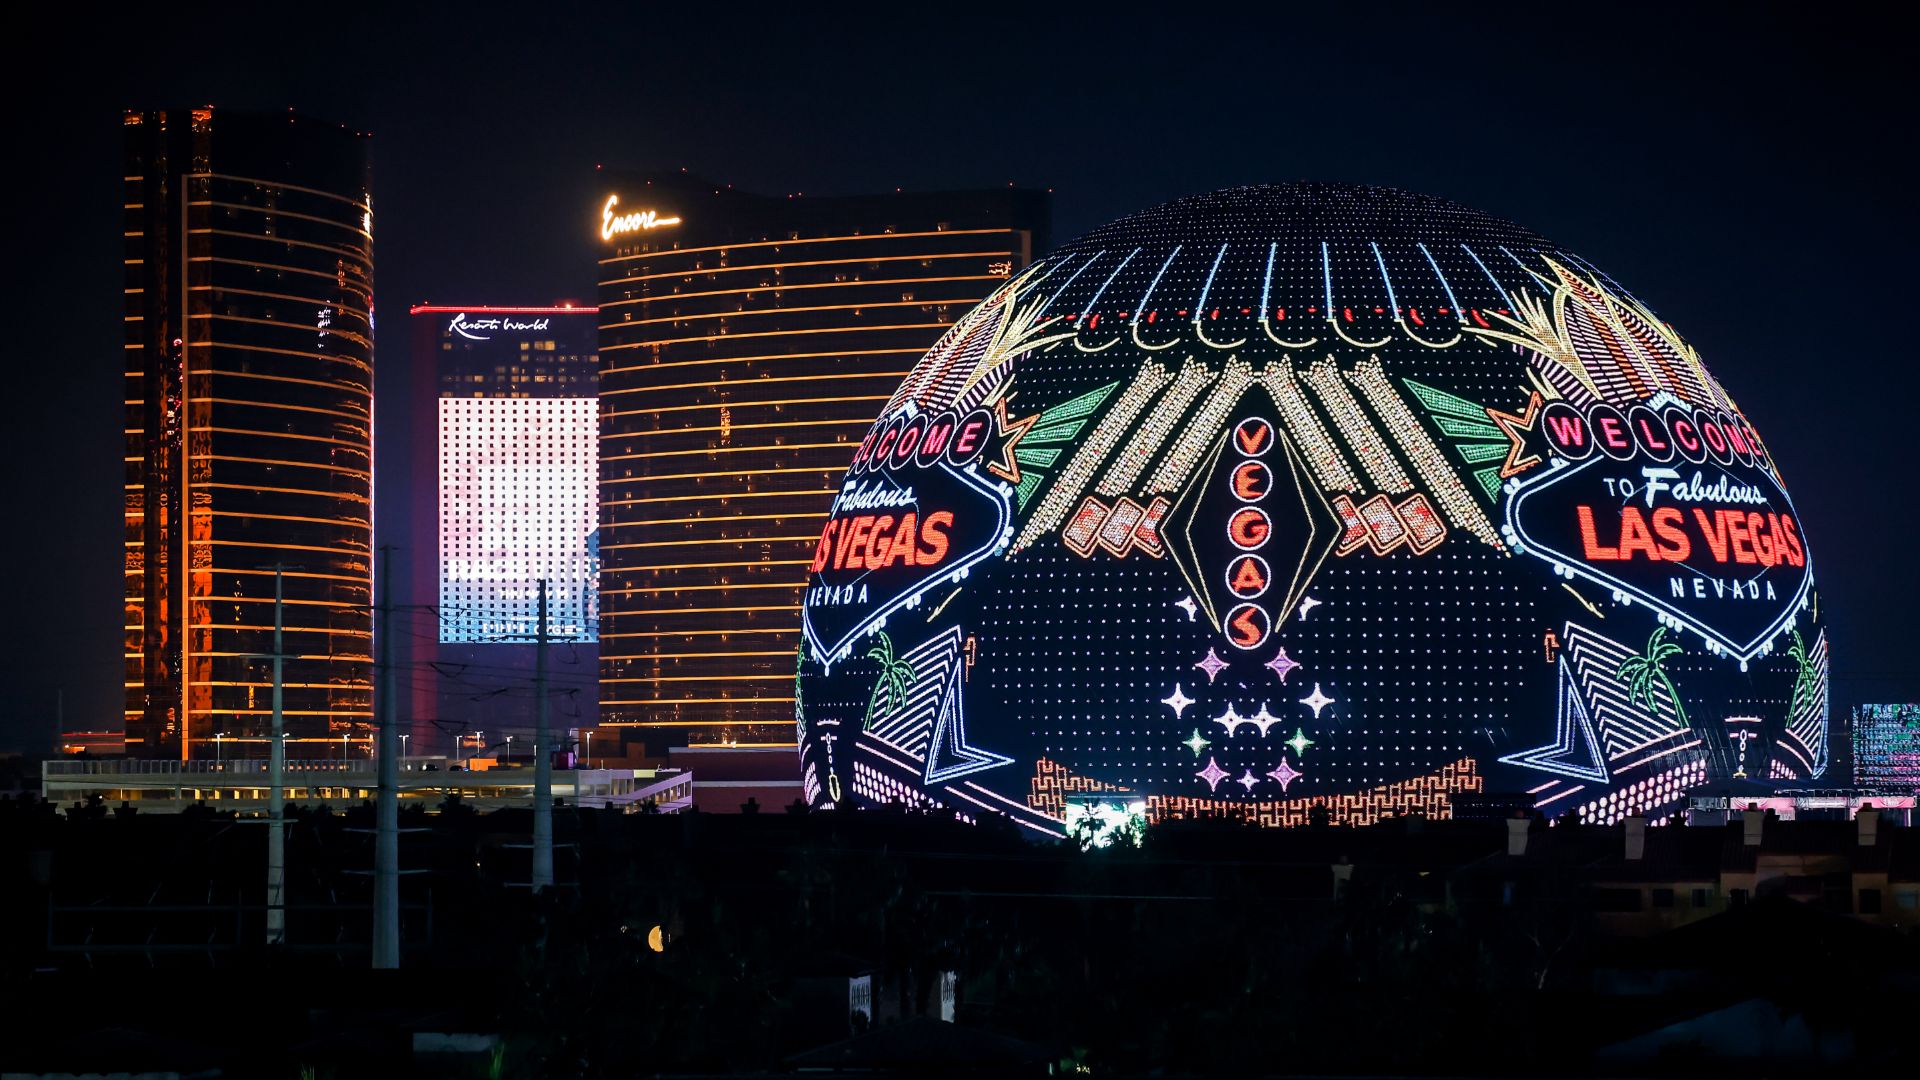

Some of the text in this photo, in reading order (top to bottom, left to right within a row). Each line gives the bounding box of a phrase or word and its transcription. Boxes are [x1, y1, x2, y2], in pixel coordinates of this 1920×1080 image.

[601, 195, 681, 241] Encore
[449, 313, 550, 339] Resorts World
[1549, 416, 1762, 456] WELCOME
[831, 480, 917, 520] Fabulous
[1603, 465, 1767, 507] TO Fabulous
[833, 511, 954, 570] VEGAS
[1230, 425, 1269, 647] VEGAS
[1577, 506, 1805, 567] LAS VEGAS
[809, 583, 868, 607] NEVADA
[1670, 577, 1777, 600] NEVADA
